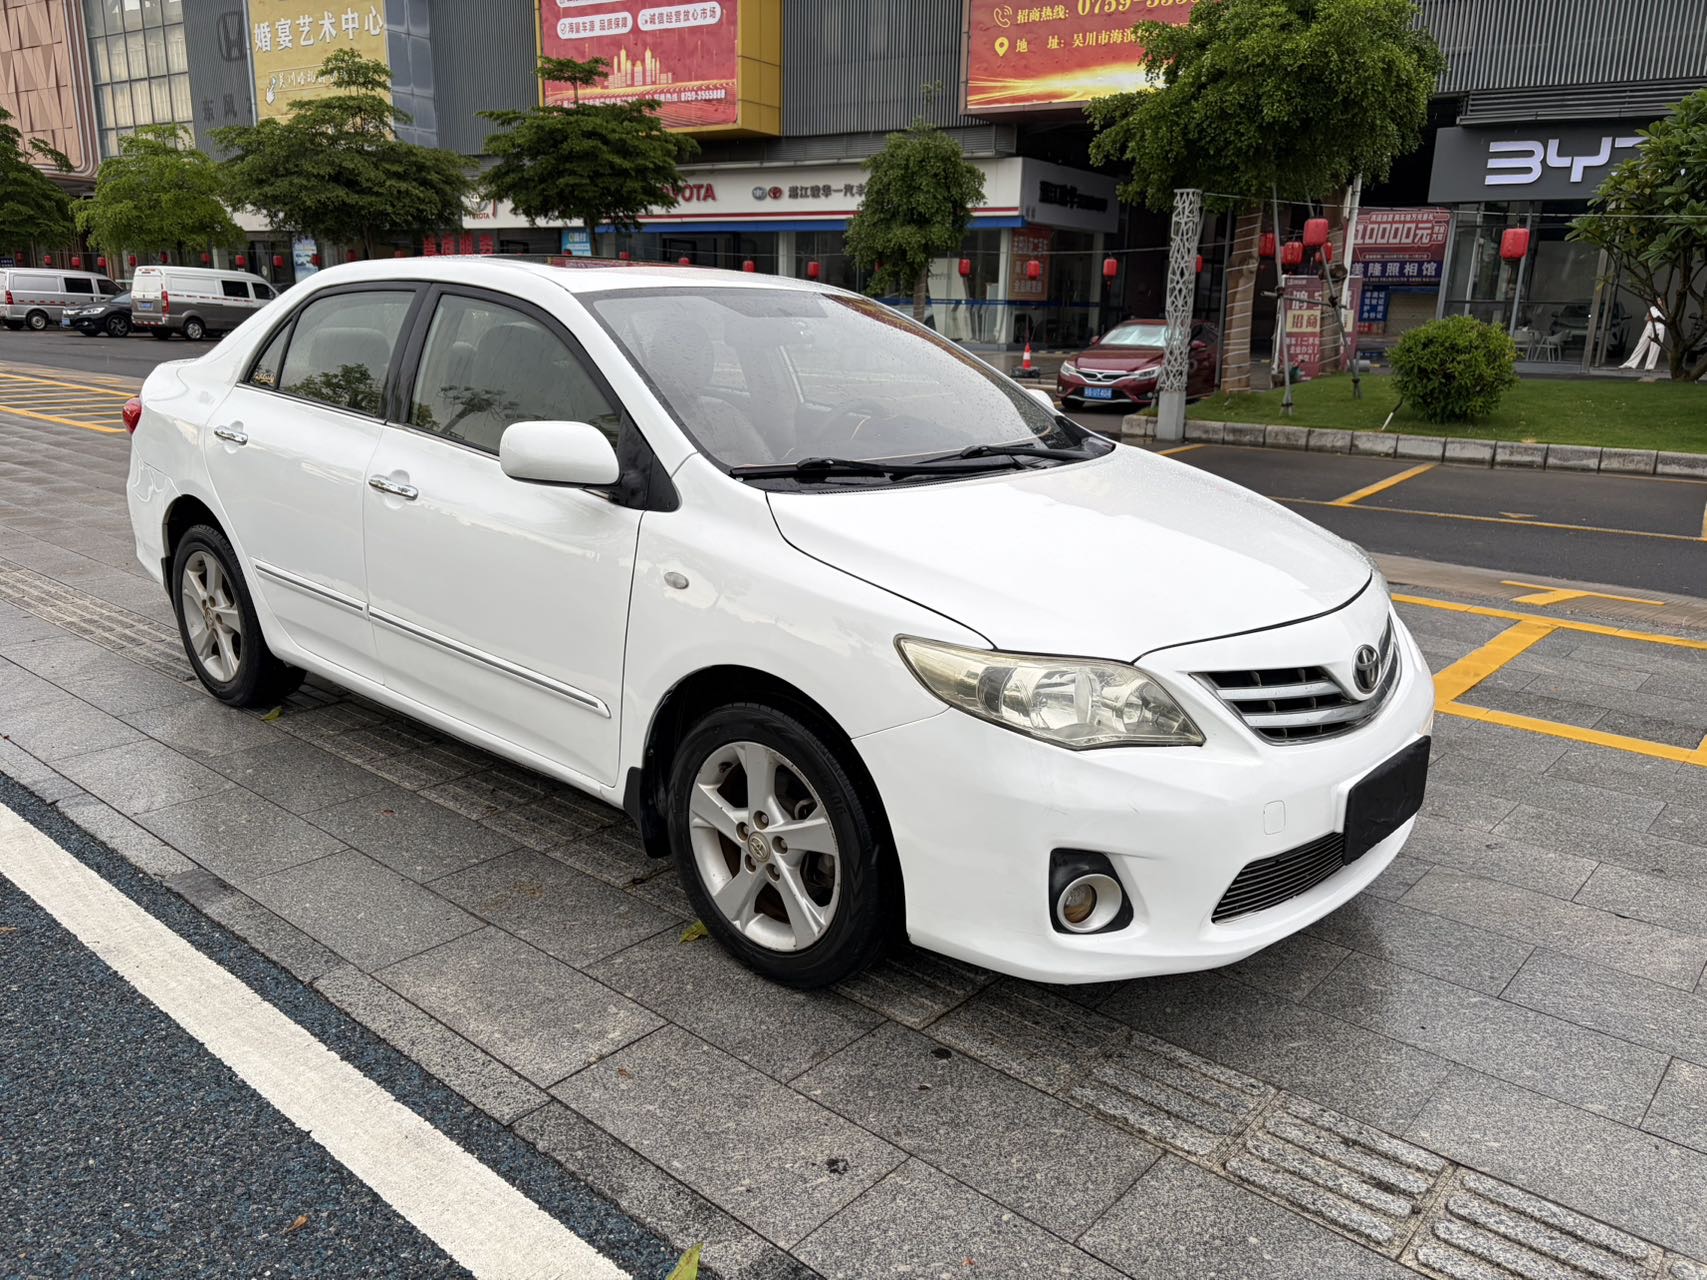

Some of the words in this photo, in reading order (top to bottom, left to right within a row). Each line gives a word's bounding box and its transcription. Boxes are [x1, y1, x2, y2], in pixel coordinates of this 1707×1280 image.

[648, 6, 718, 25] 诚信经营放心市场
[1017, 4, 1069, 24] 招商热线：
[254, 6, 384, 52] 婚宴艺术中心
[1072, 27, 1146, 48] 吴川市海滨
[1484, 136, 1650, 186] BY
